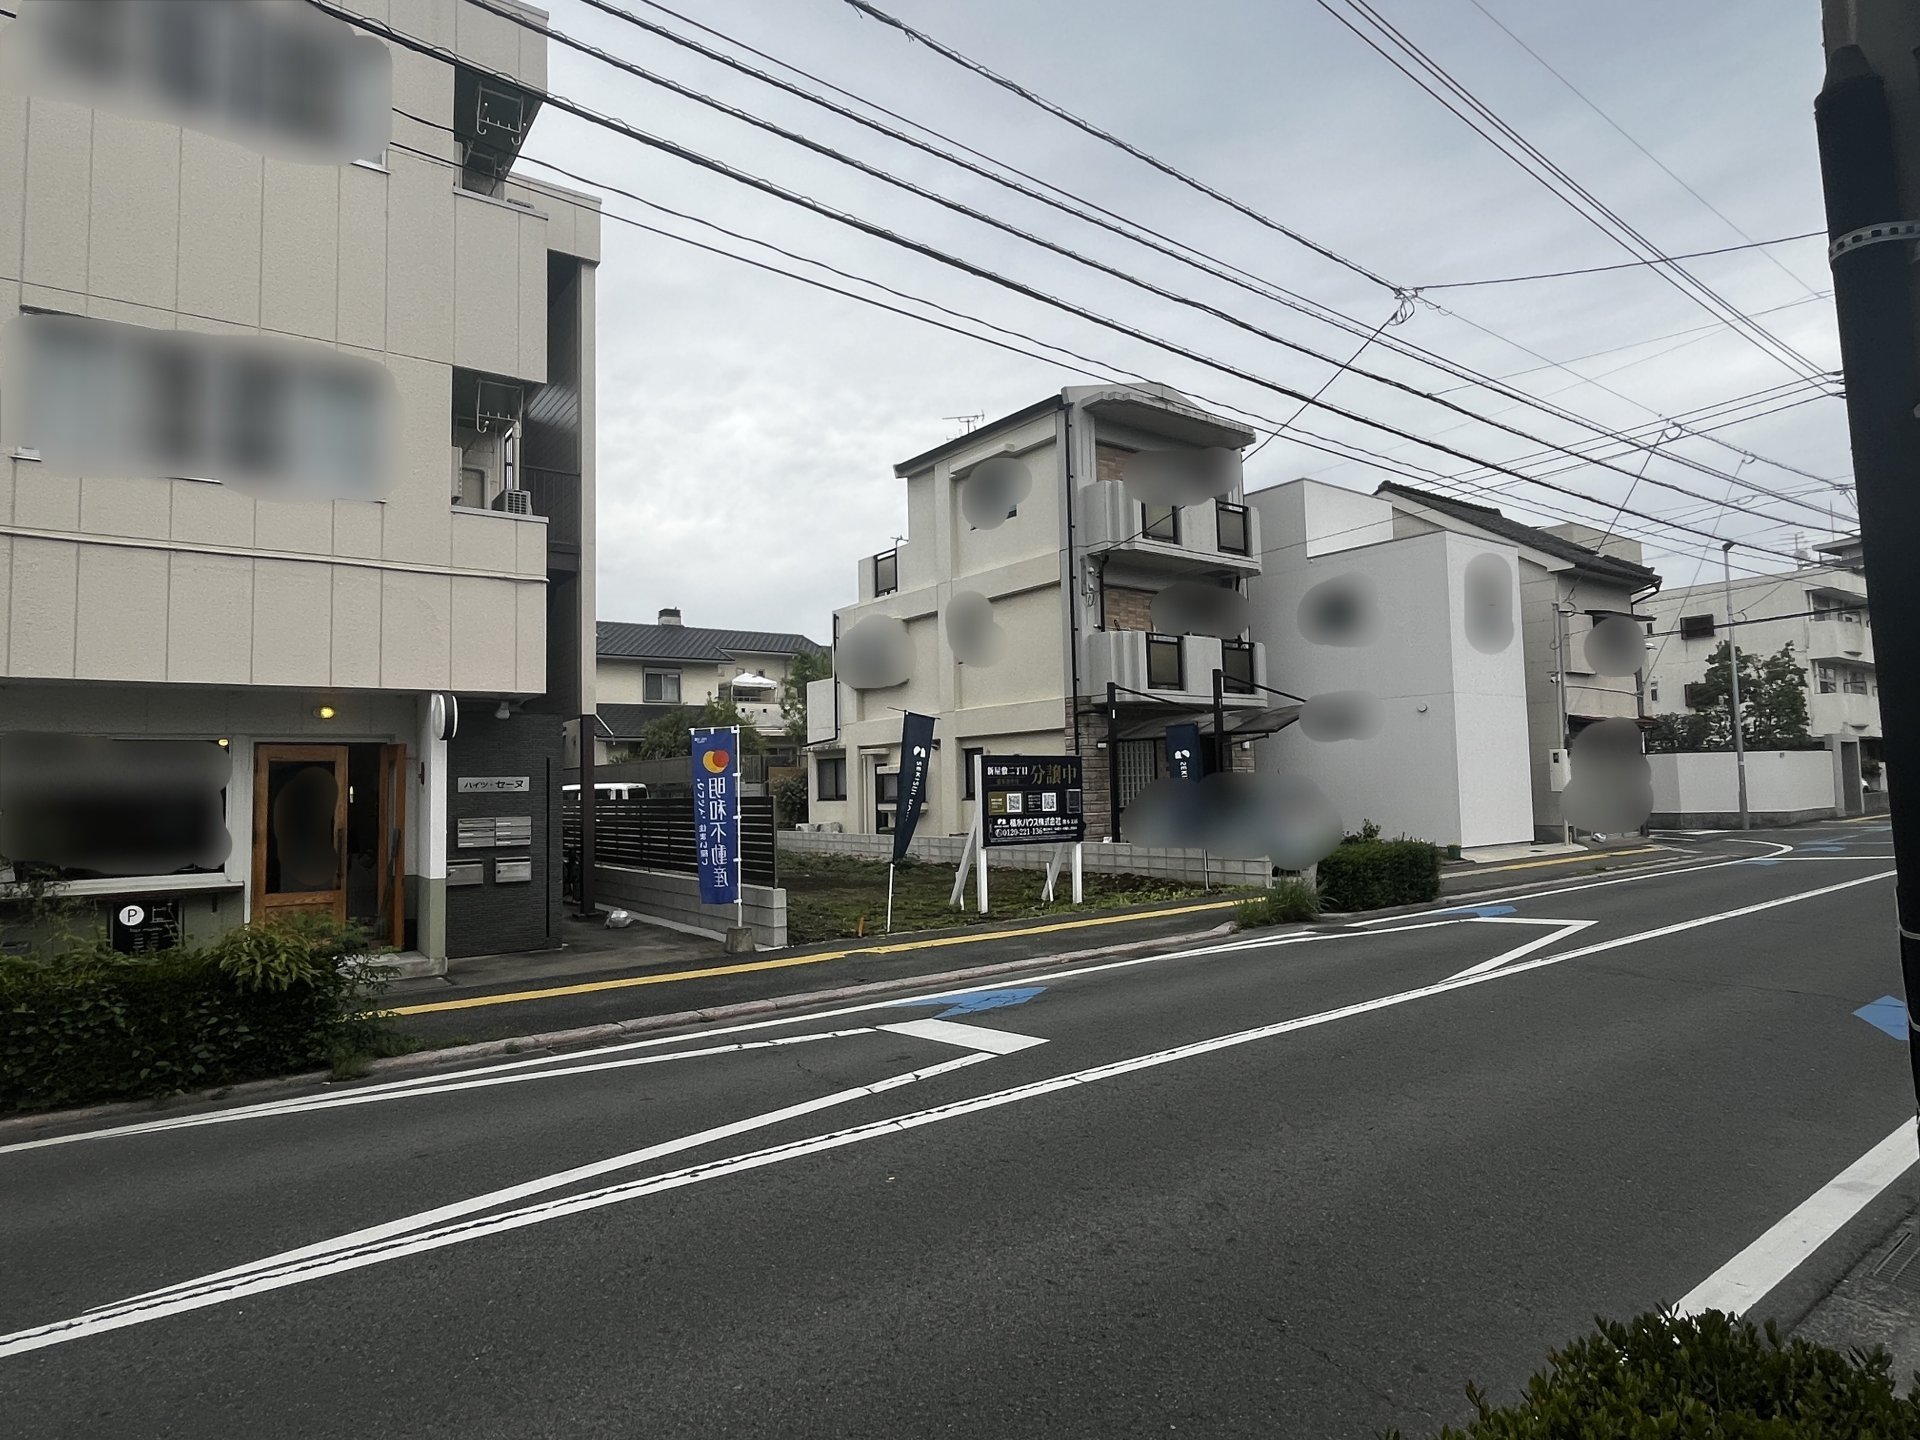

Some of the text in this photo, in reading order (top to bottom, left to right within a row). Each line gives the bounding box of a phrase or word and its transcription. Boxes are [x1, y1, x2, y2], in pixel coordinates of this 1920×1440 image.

[464, 780, 524, 789] ハイツ・セーヌ
[910, 761, 923, 796] SEKISUI
[1030, 763, 1077, 785] 分譲中
